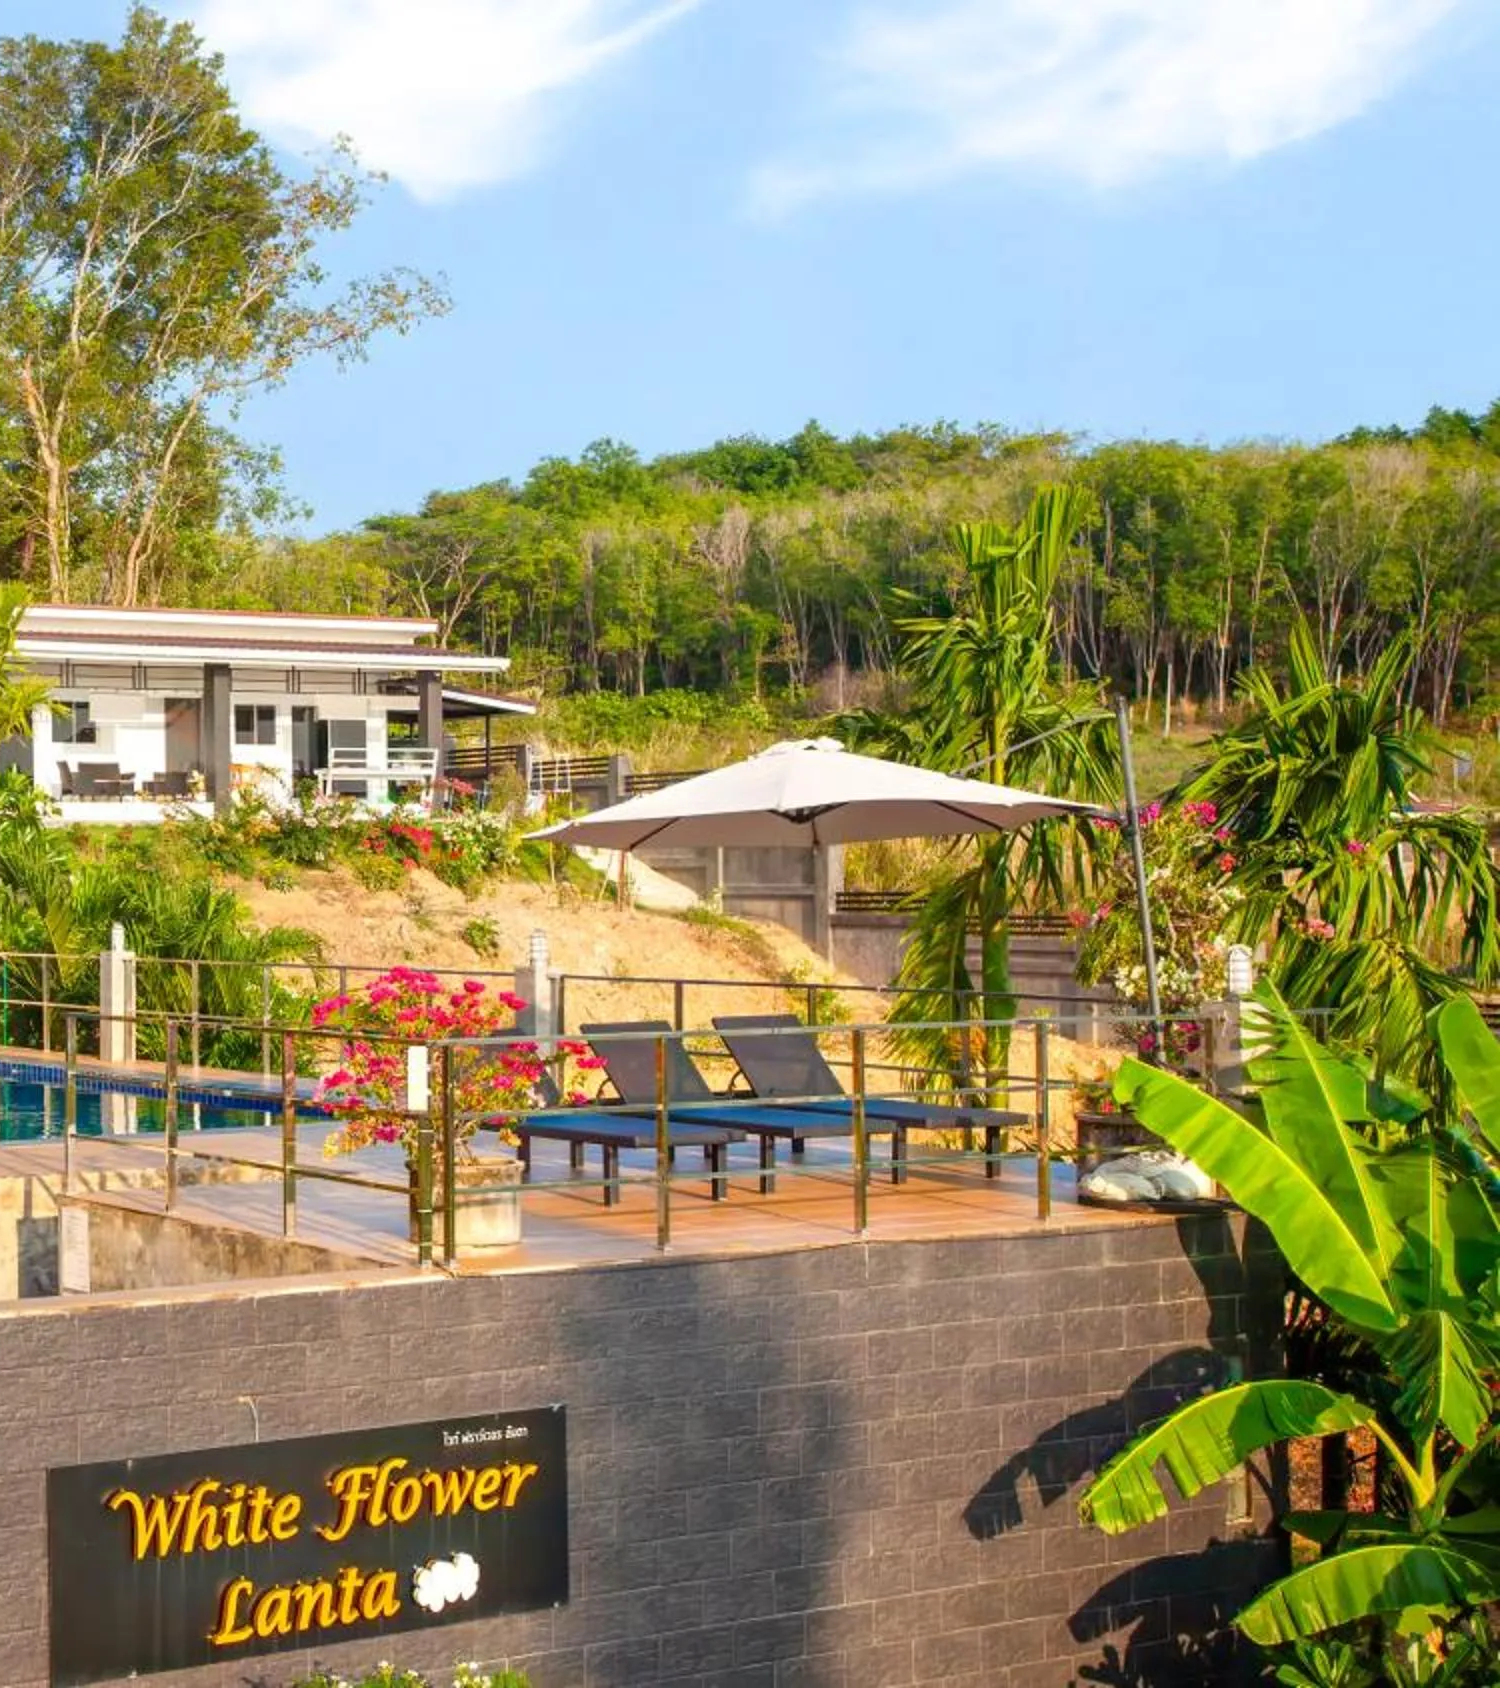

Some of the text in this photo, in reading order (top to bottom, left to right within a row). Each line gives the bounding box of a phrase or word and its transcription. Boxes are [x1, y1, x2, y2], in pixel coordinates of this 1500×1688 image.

[107, 1457, 539, 1560] White Flower
[208, 1566, 401, 1645] Lanta
